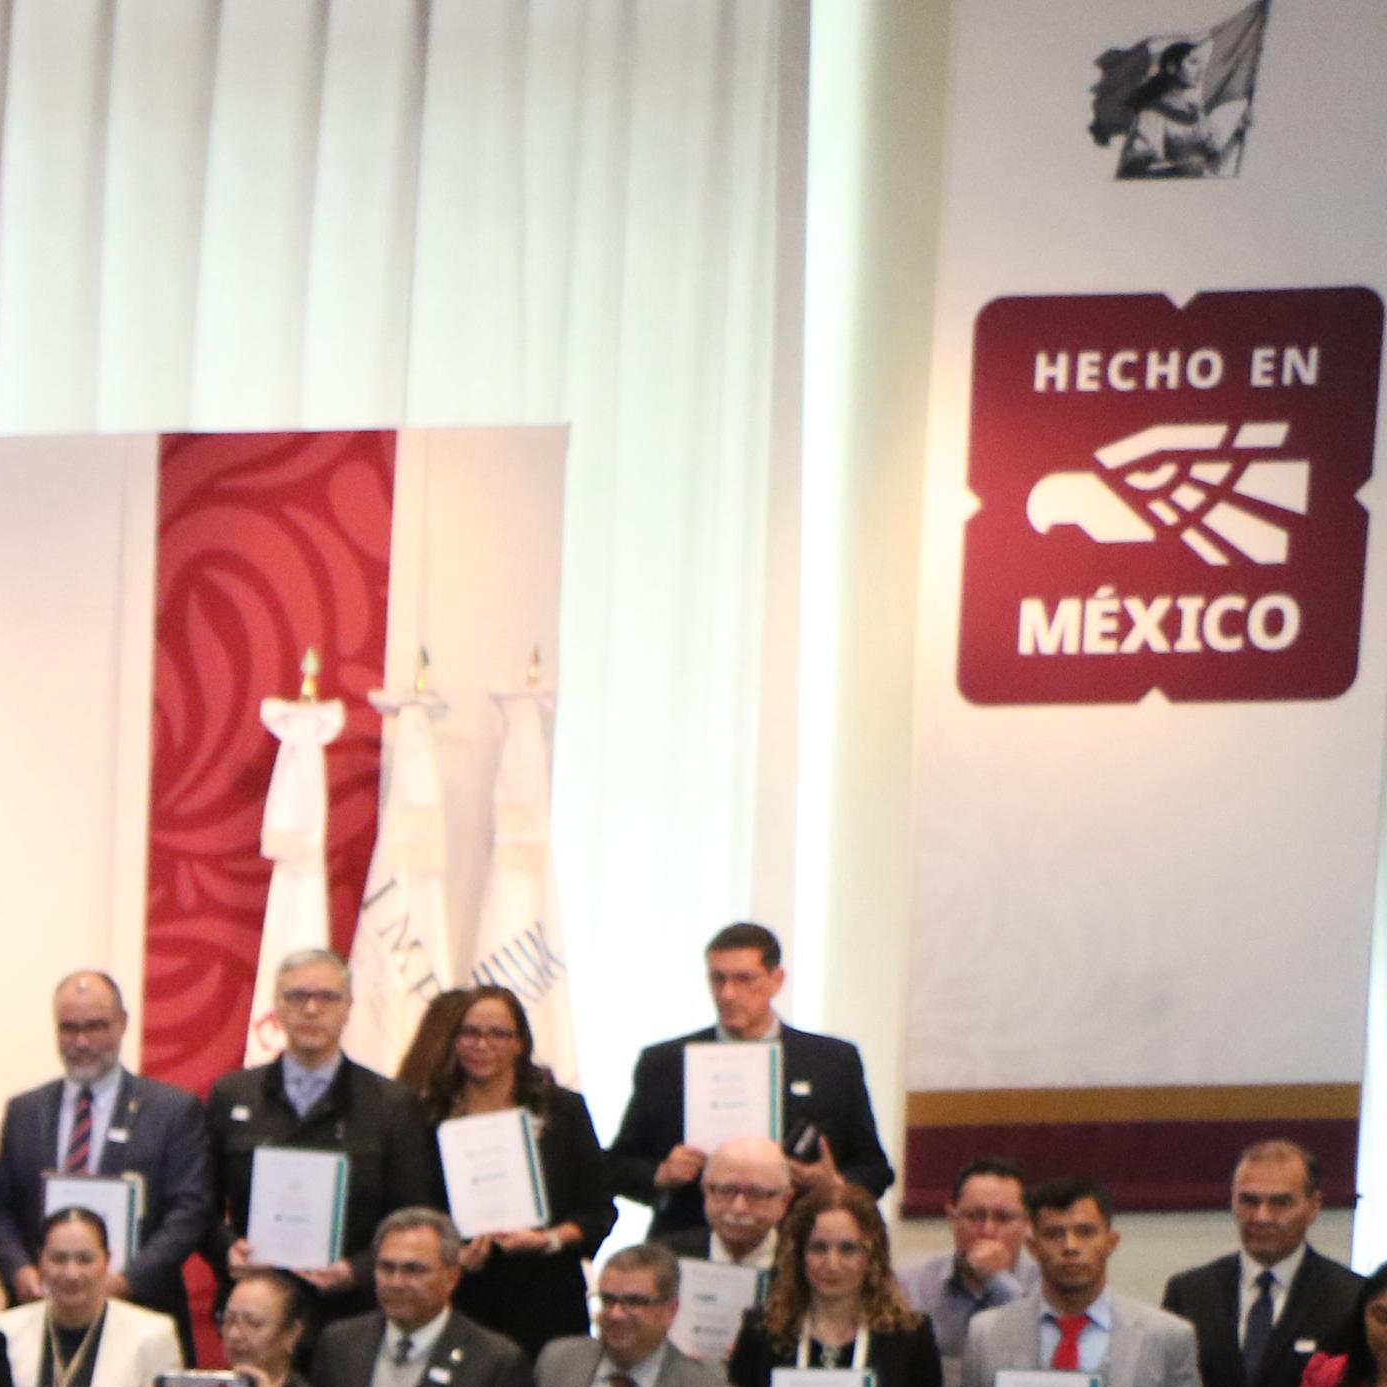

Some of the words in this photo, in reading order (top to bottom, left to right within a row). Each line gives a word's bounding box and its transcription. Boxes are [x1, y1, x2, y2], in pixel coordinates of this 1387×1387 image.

[1033, 346, 1226, 393] HECHO
[1250, 345, 1321, 388] EN
[1017, 584, 1303, 656] MÉXICO
